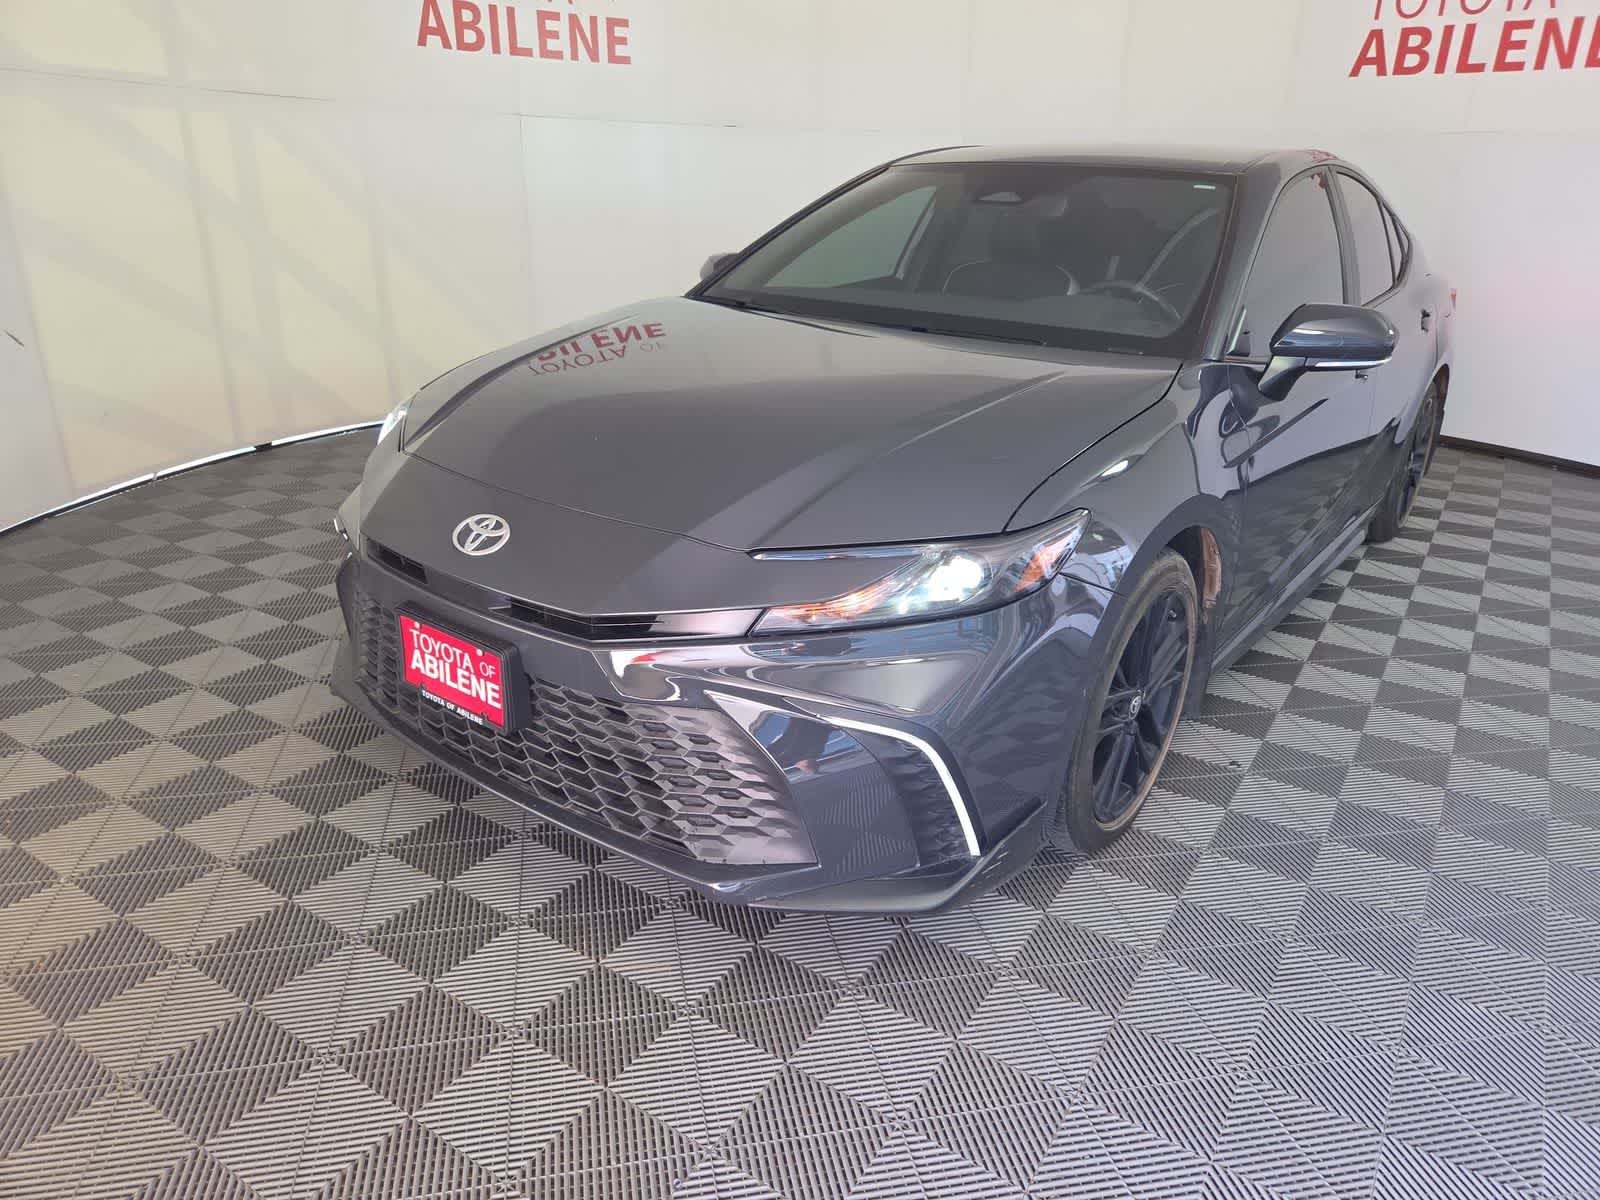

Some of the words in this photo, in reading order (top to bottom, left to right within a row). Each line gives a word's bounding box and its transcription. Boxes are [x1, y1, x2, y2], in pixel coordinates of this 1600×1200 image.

[417, 0, 631, 65] ABILENE
[409, 628, 474, 673] TOYOTA
[479, 662, 496, 678] OF
[411, 649, 502, 709] ABILENE
[421, 690, 445, 706] TOYOTA
[446, 701, 455, 711] OF
[457, 706, 483, 725] ABILENE
